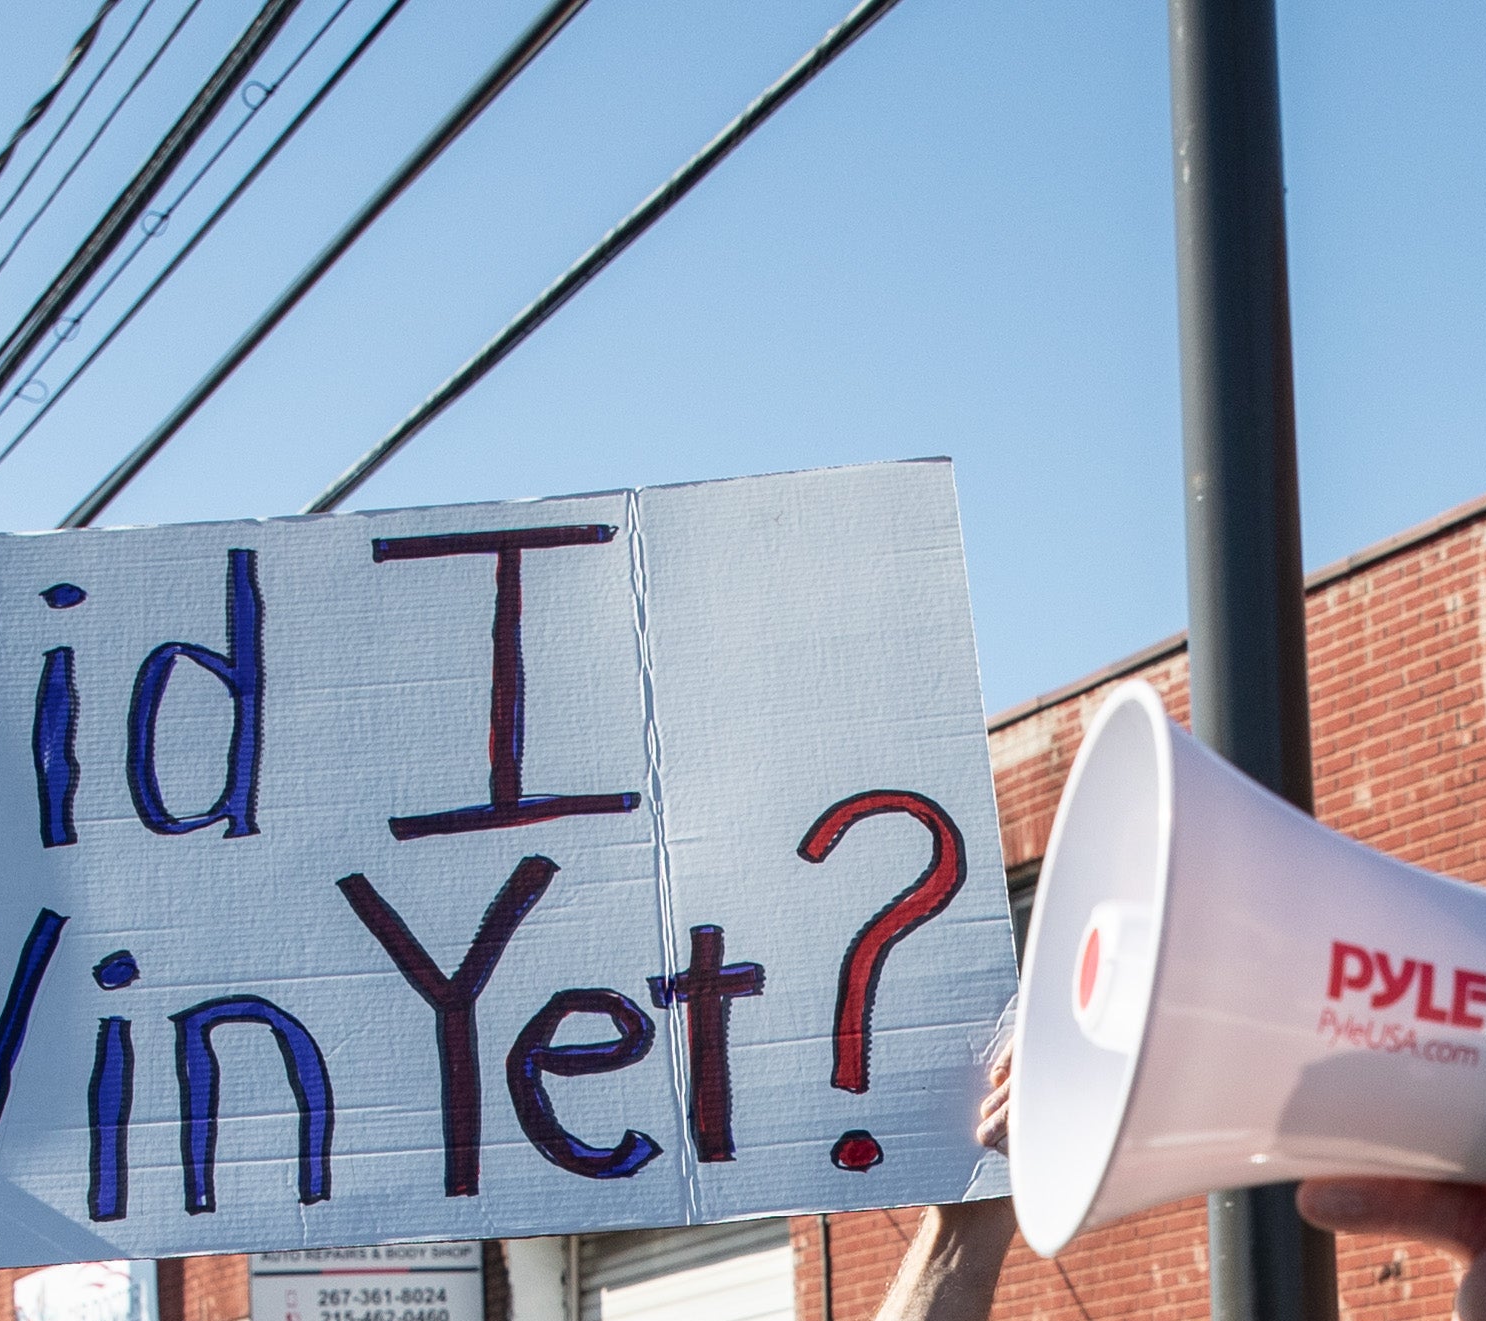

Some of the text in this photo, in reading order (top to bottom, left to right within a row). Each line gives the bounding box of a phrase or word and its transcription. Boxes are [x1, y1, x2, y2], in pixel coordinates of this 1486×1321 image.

[371, 523, 642, 841] I
[334, 789, 967, 1198] Yet?
[1316, 1008, 1481, 1067] PyleUSA.com
[259, 1247, 473, 1262] AUTO REPAIRS & BODY SHOP
[318, 1287, 447, 1307] 267-361-8024
